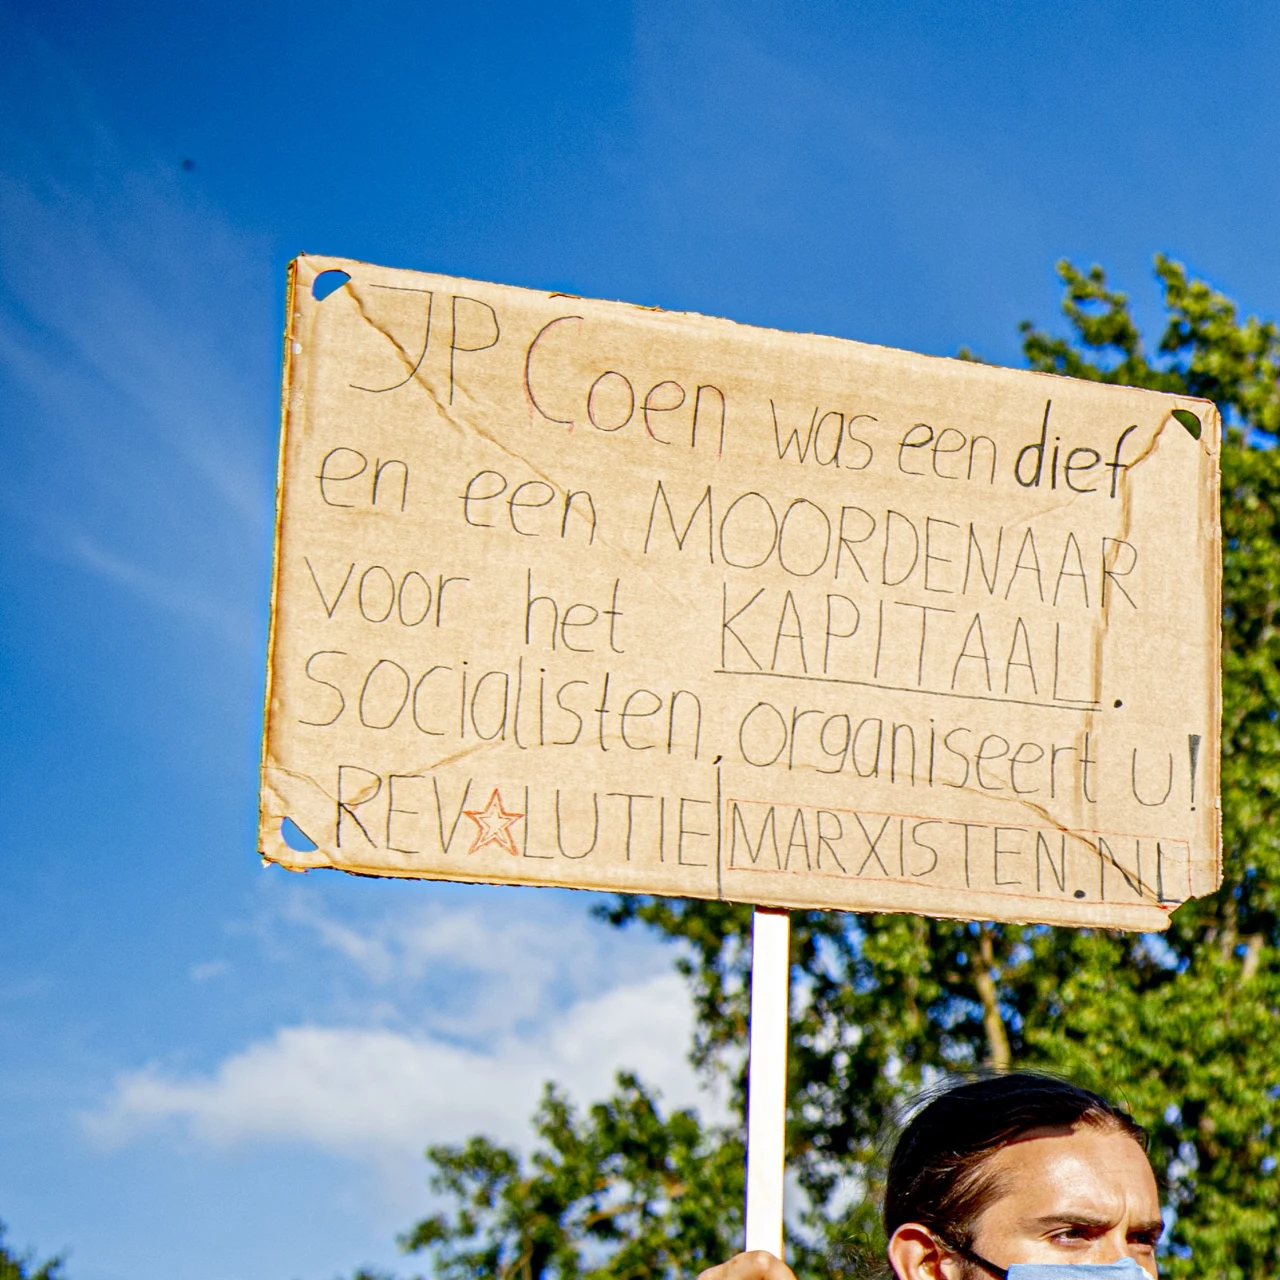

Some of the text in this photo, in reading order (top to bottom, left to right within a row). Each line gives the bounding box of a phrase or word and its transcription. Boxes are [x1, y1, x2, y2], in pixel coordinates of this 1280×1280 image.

[349, 283, 1138, 499] JP Coen was een dief
[315, 446, 1138, 610] en een MOORDENAAR
[303, 556, 1124, 709] voor het KAPITAAL.
[738, 701, 1097, 804] organiseert
[730, 801, 1182, 904] MARXISTEN.NL
